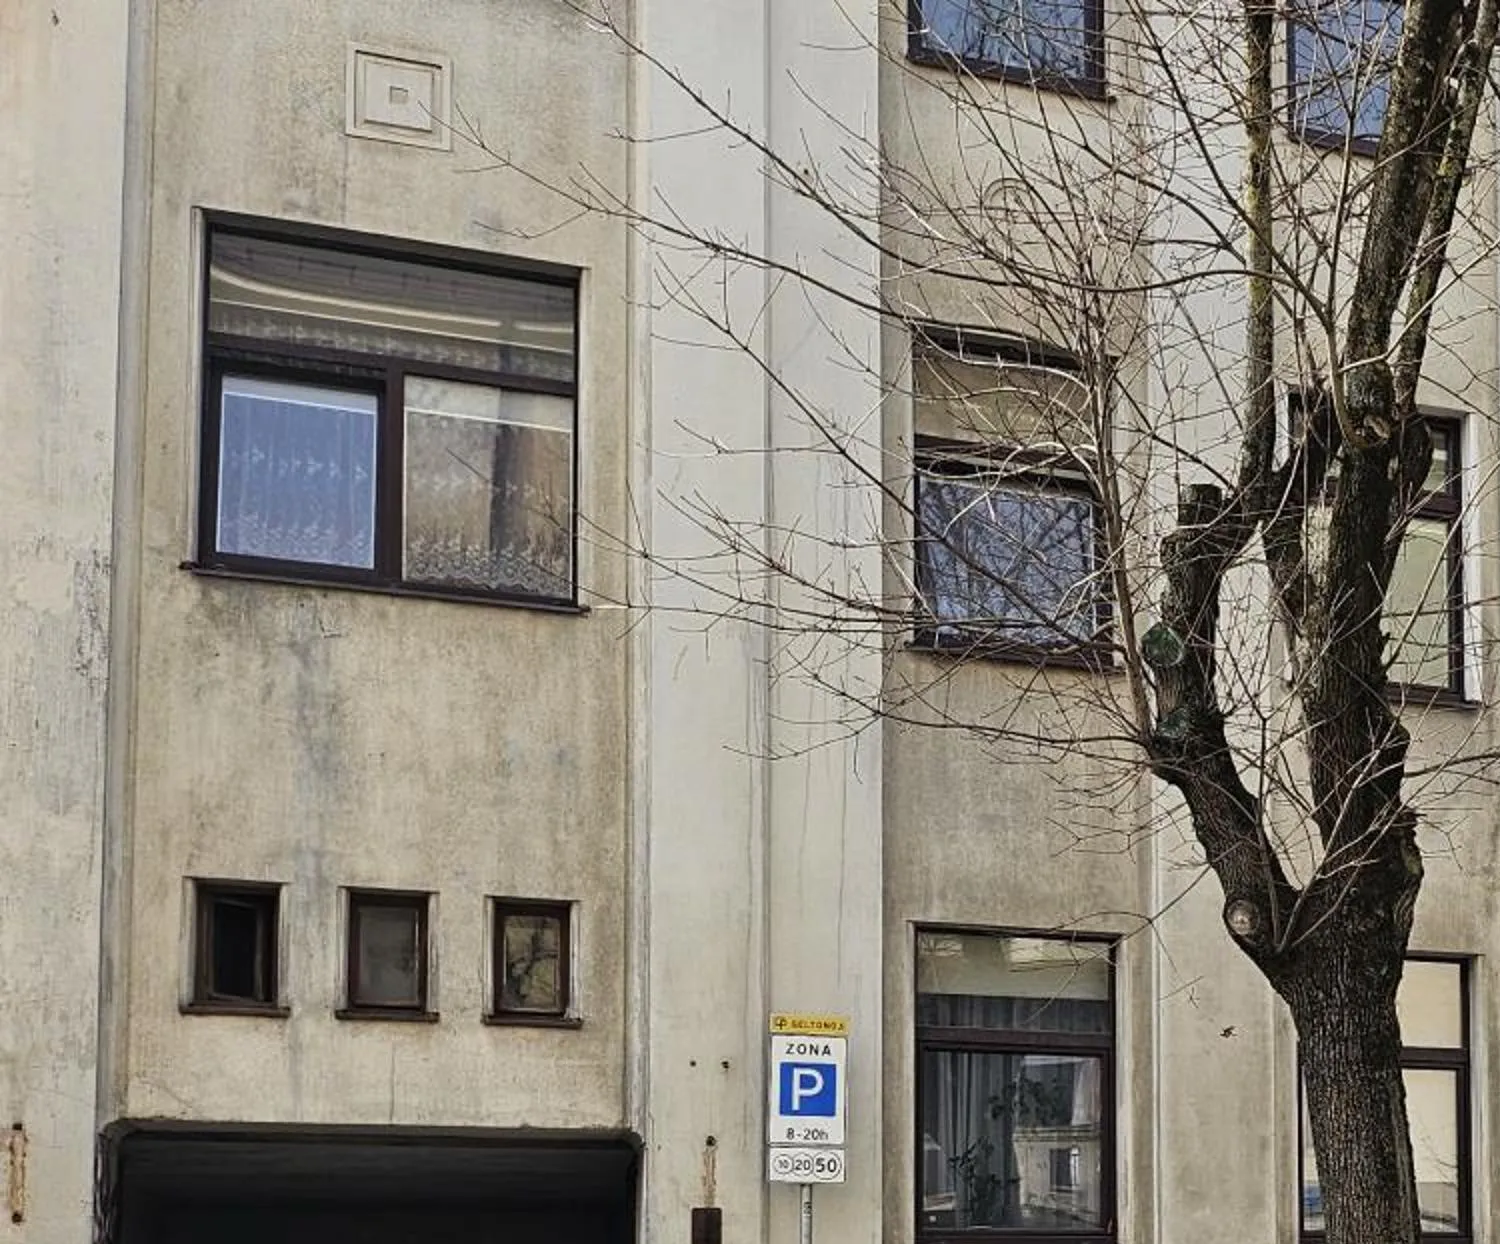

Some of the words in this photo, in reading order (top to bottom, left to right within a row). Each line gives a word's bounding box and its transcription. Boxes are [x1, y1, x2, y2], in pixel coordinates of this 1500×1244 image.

[786, 1043, 831, 1057] ZONA
[792, 1068, 824, 1111] P
[795, 1159, 811, 1171] 20
[815, 1157, 837, 1173] 50
